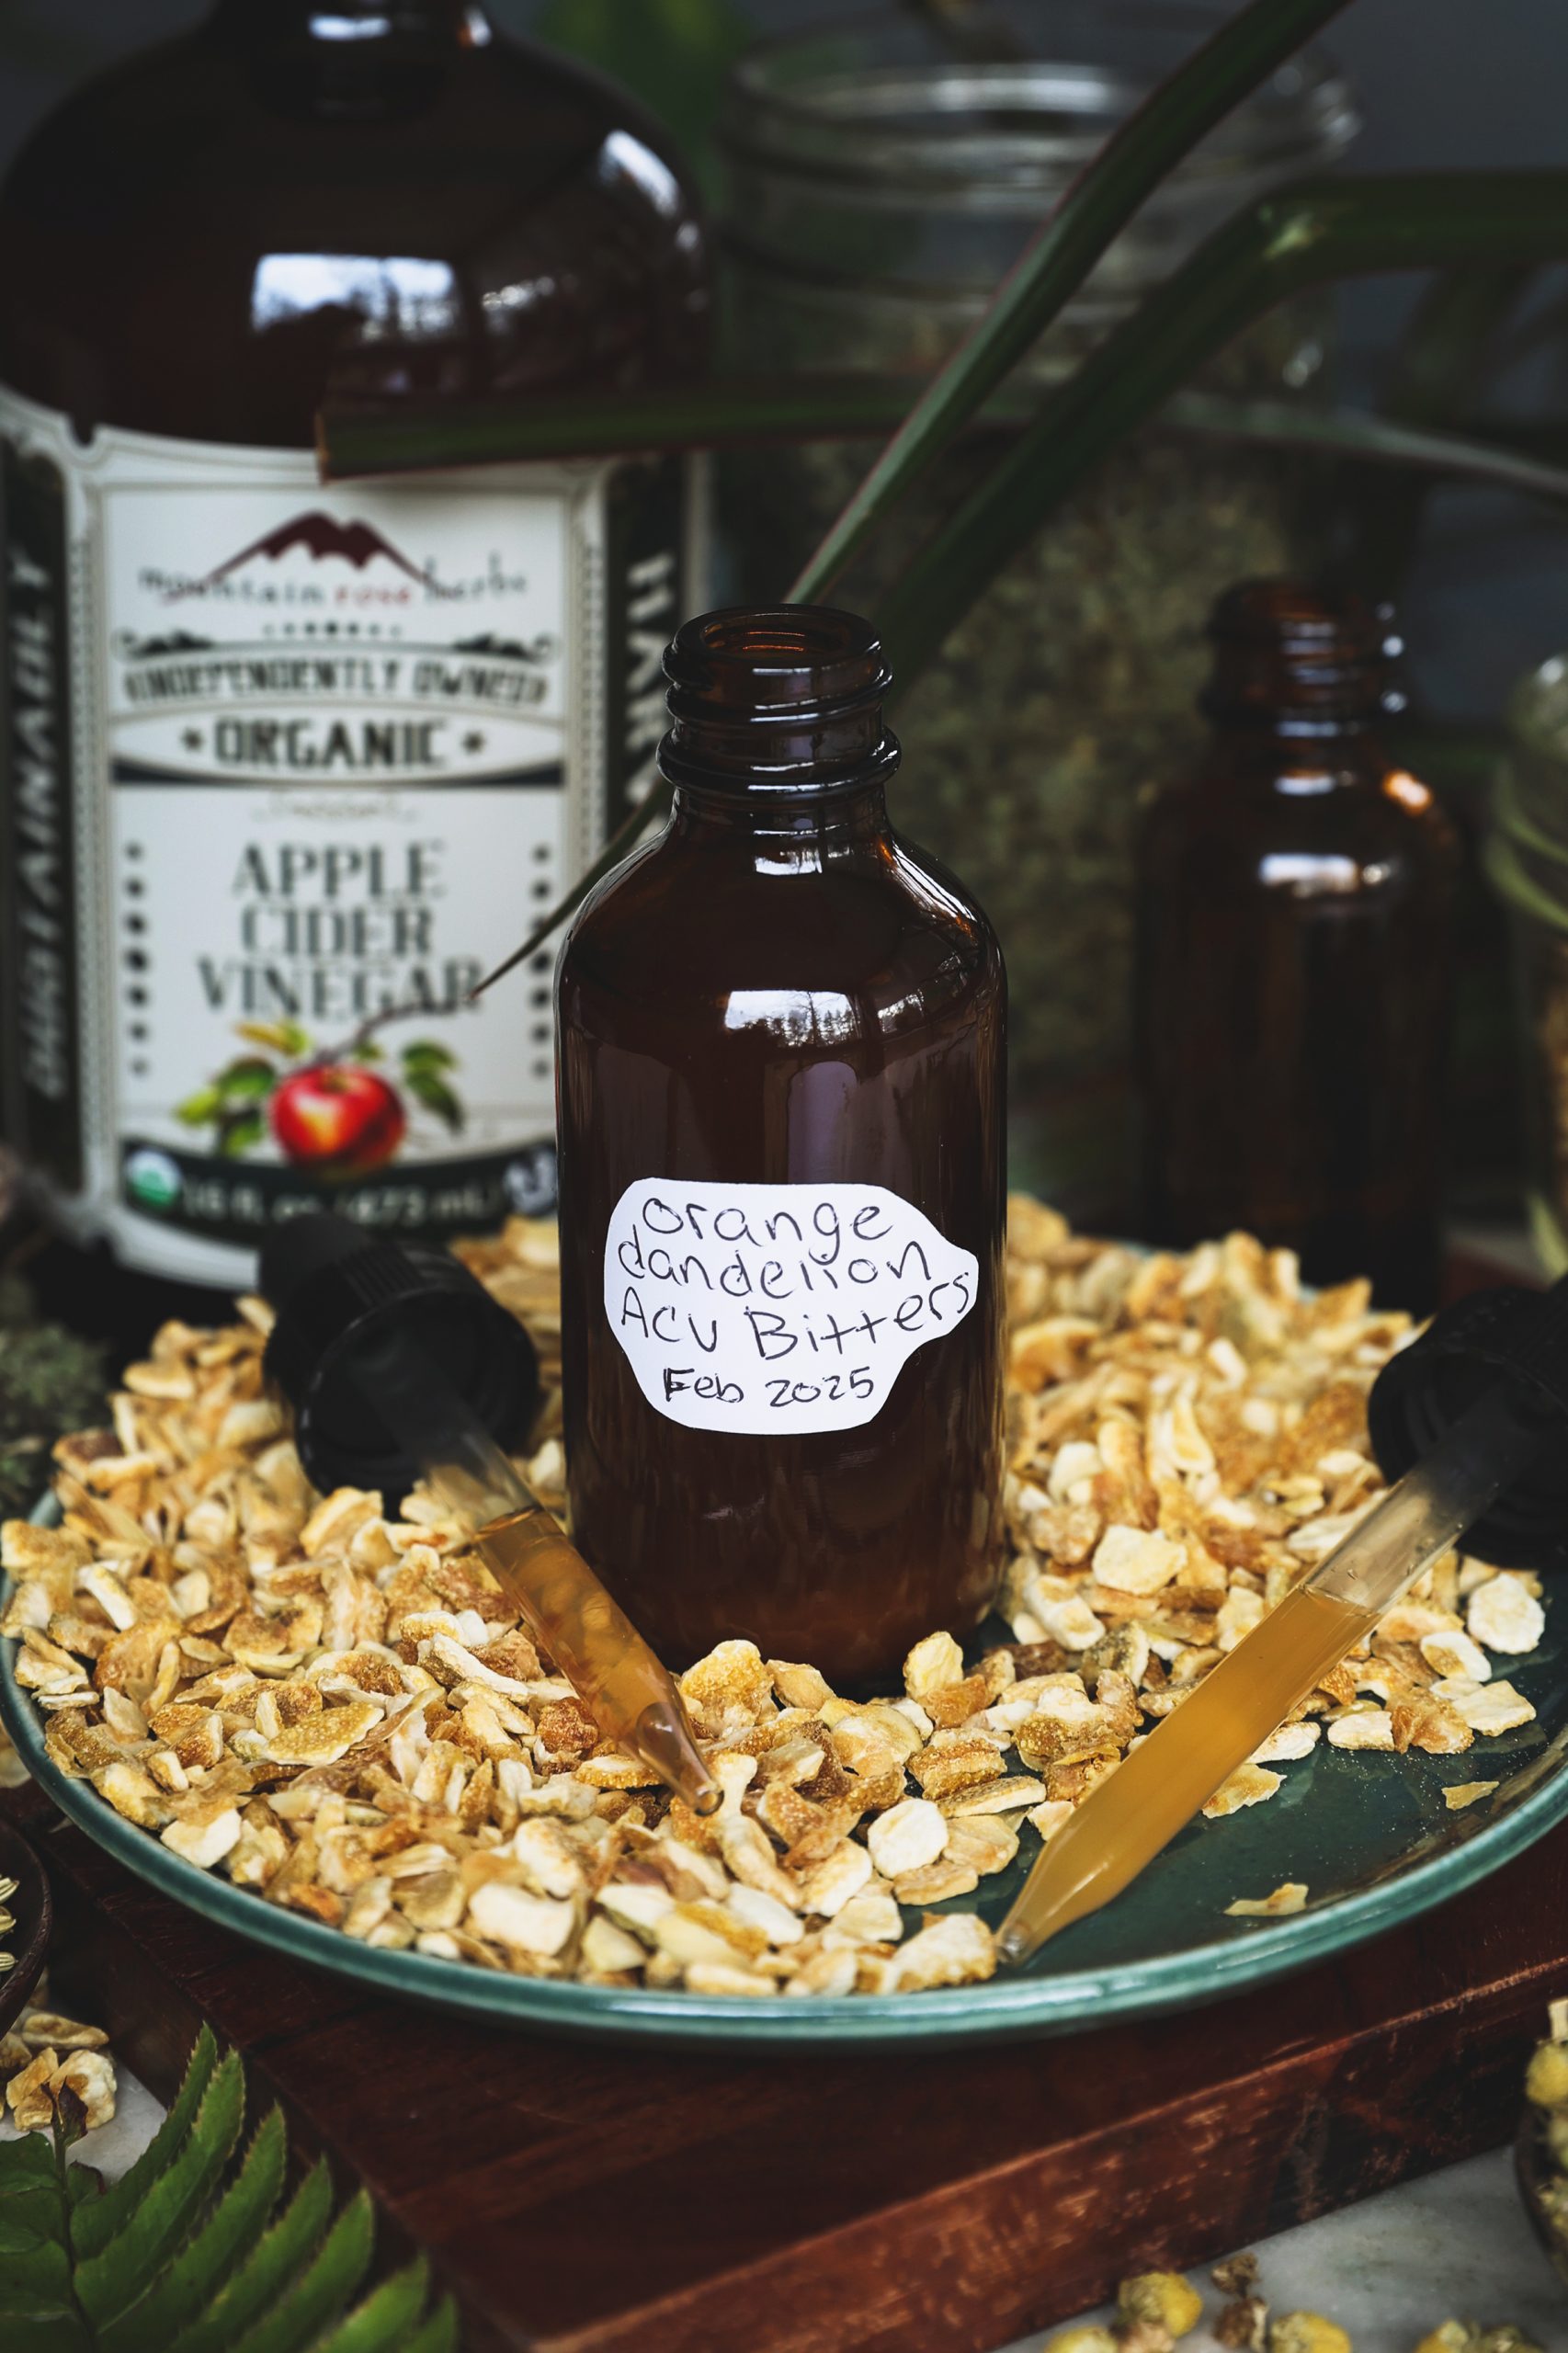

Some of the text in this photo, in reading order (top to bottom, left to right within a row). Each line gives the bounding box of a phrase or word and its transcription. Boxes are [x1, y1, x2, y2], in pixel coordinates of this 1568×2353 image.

[213, 718, 444, 767] ORGANIC
[233, 842, 445, 897] APPLE
[242, 901, 435, 956] CIDER
[197, 952, 483, 1017] VINEGAR
[744, 1272, 970, 1360] Bitters
[663, 1366, 874, 1407] Feb 2025
